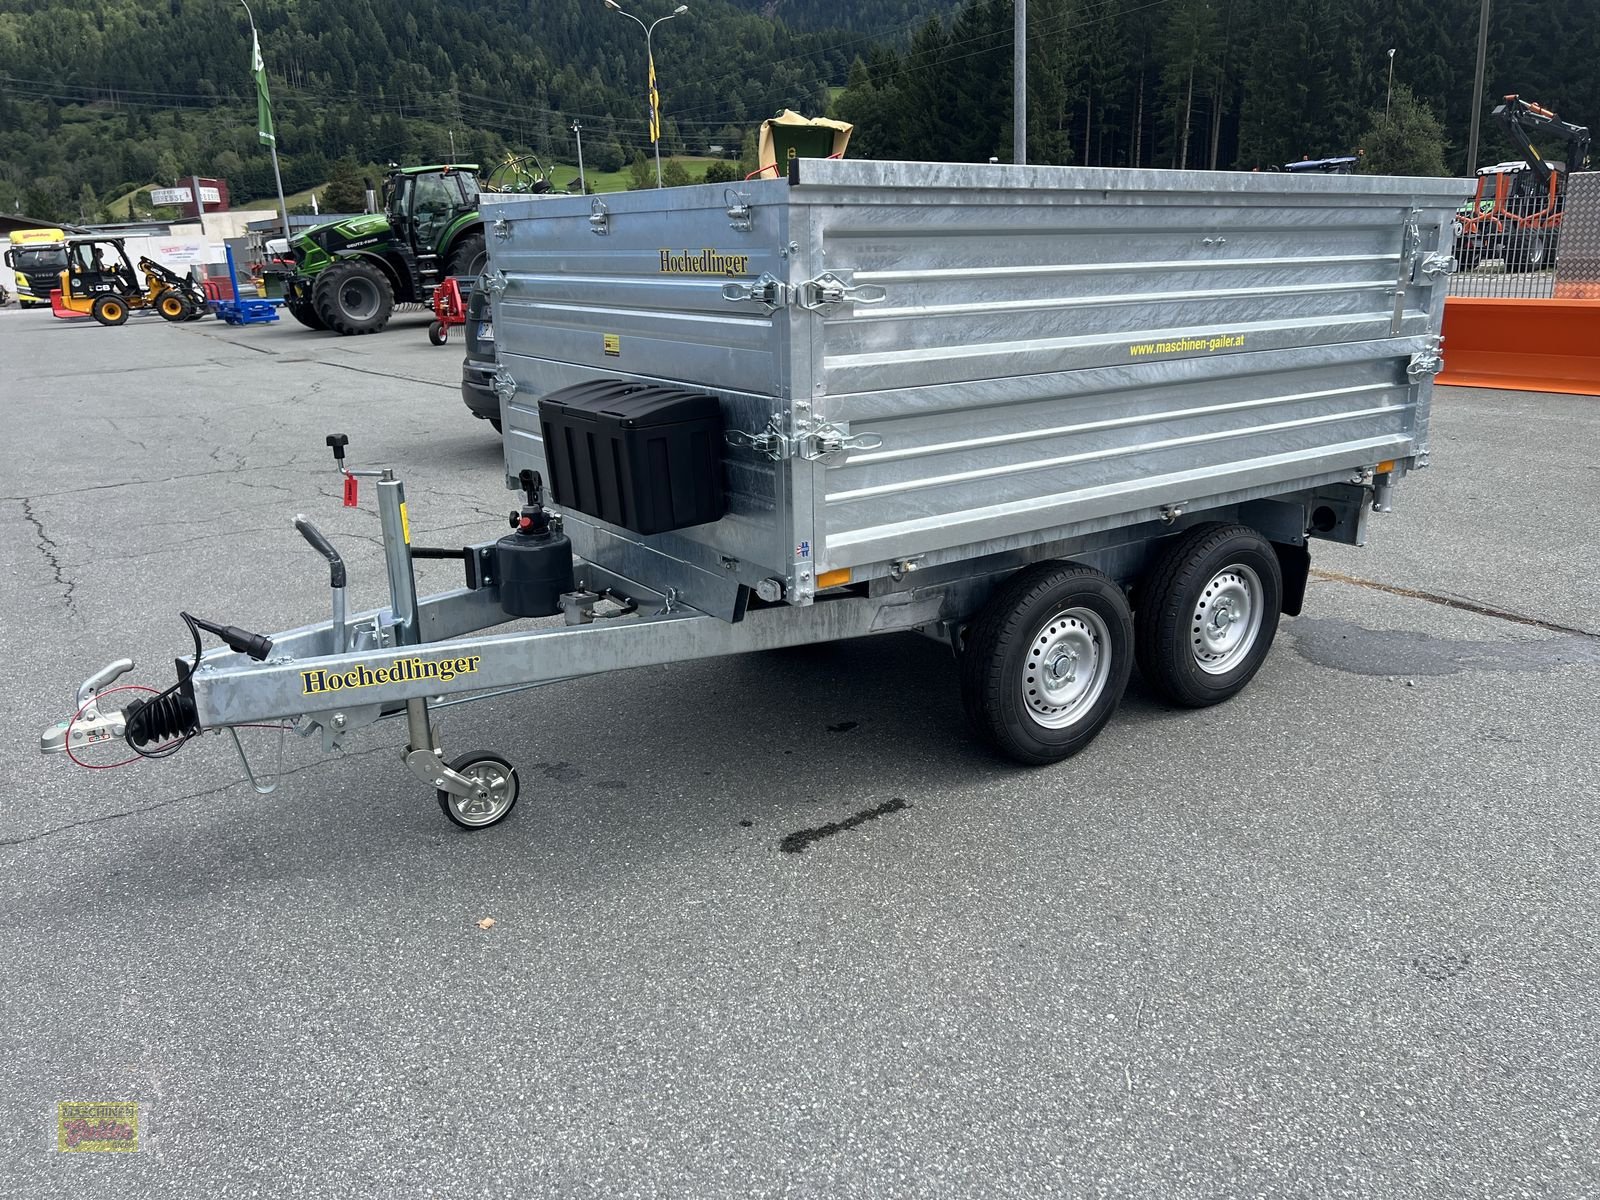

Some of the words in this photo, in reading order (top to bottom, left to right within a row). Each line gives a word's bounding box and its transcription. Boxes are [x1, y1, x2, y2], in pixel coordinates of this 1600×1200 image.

[659, 249, 748, 278] Hochedlinger
[1129, 334, 1245, 356] www.maschinen-gailer.at
[302, 655, 480, 695] Hochedlinger
